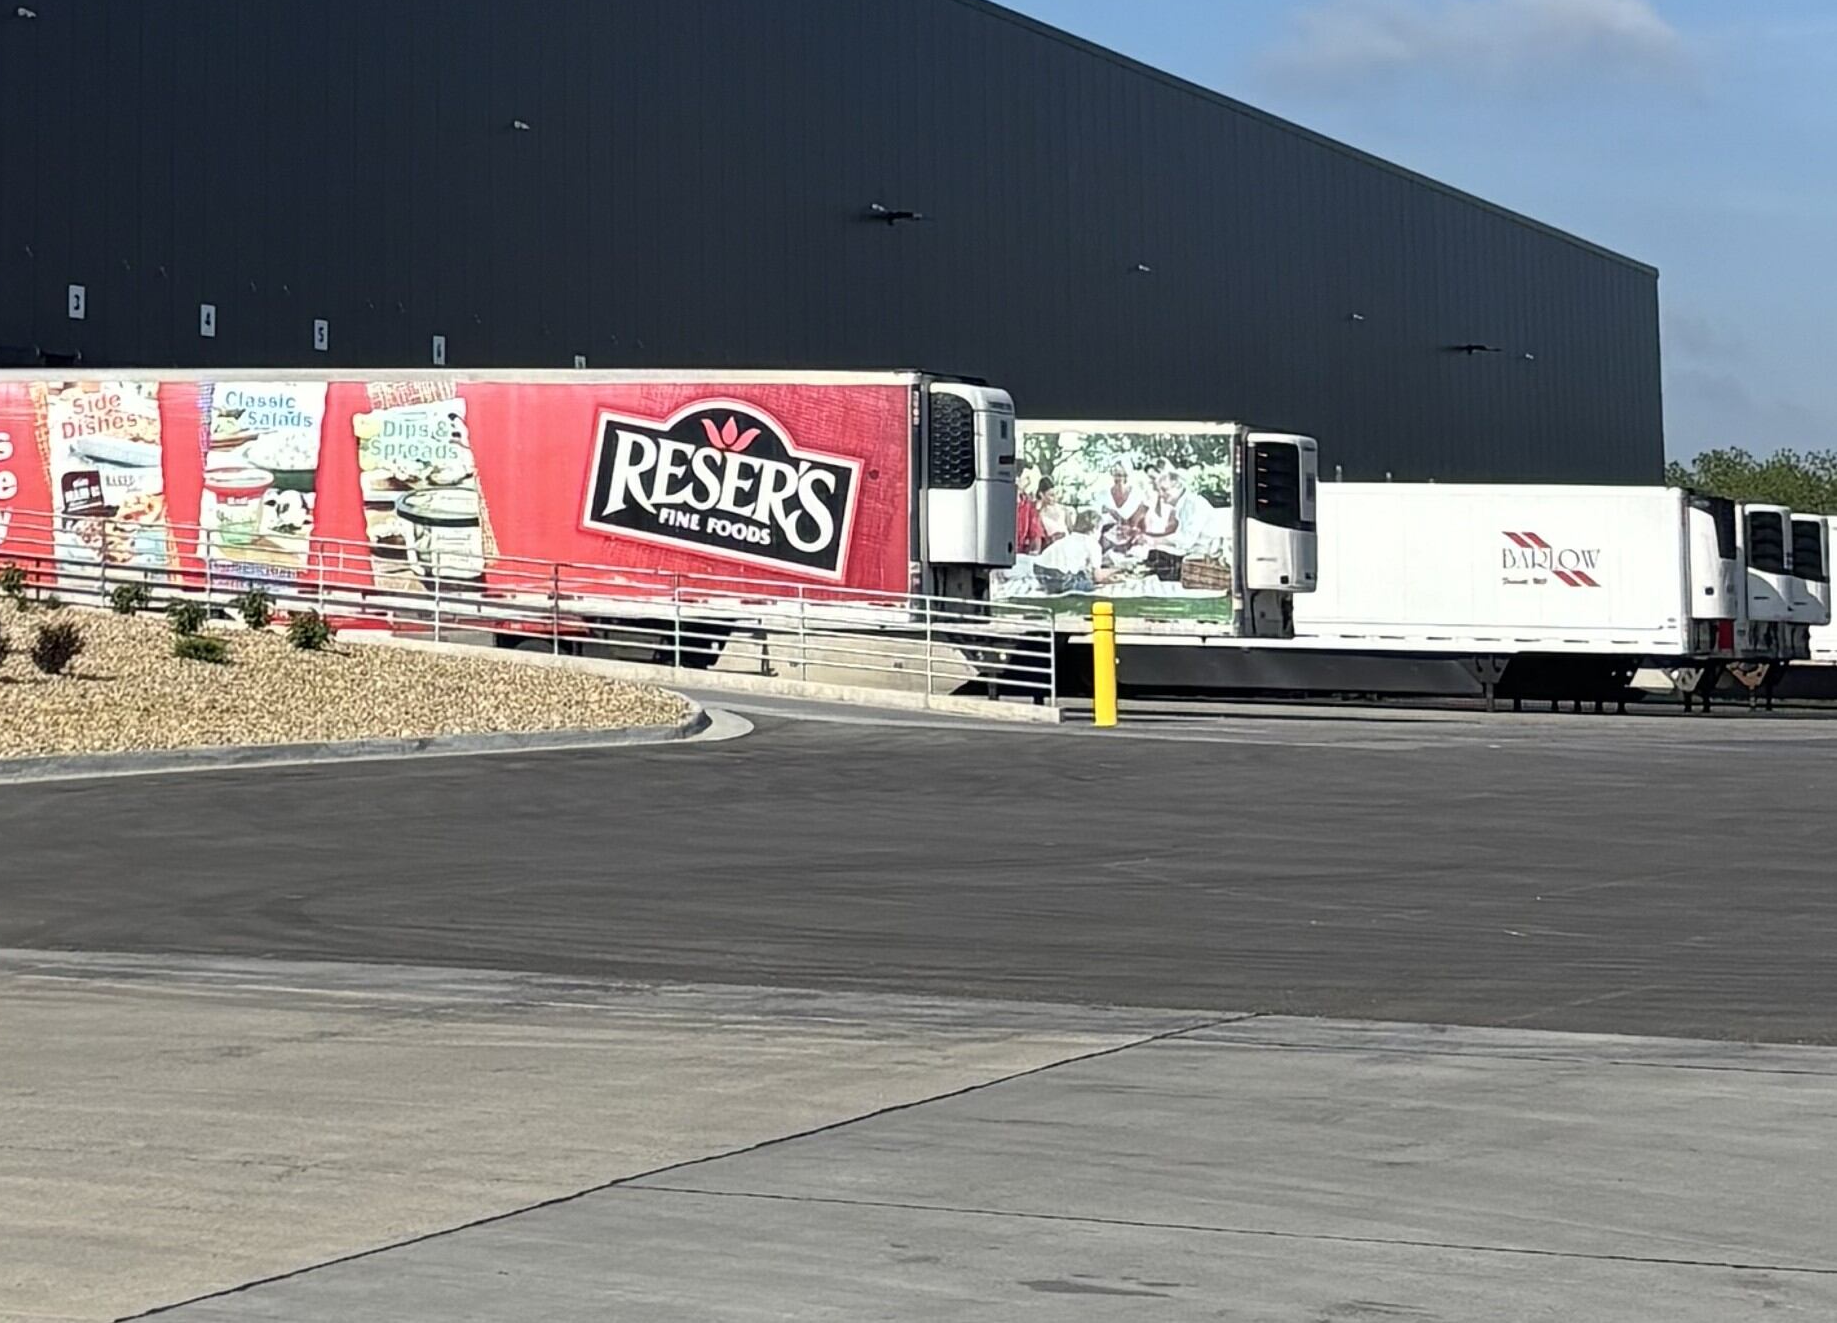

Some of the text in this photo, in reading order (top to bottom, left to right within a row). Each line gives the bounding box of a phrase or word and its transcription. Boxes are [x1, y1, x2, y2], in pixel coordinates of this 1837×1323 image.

[73, 294, 81, 311] 3
[204, 312, 212, 327] 4
[318, 326, 325, 343] 5
[73, 392, 122, 415] Side
[225, 391, 296, 409] Classic
[62, 413, 138, 439] Dishes
[248, 410, 313, 428] Salads
[383, 420, 449, 439] Dips &
[370, 440, 459, 460] Spreads
[601, 429, 837, 553] RESER'S
[658, 507, 772, 545] FINE FOODS
[1502, 547, 1601, 570] BARLOW
